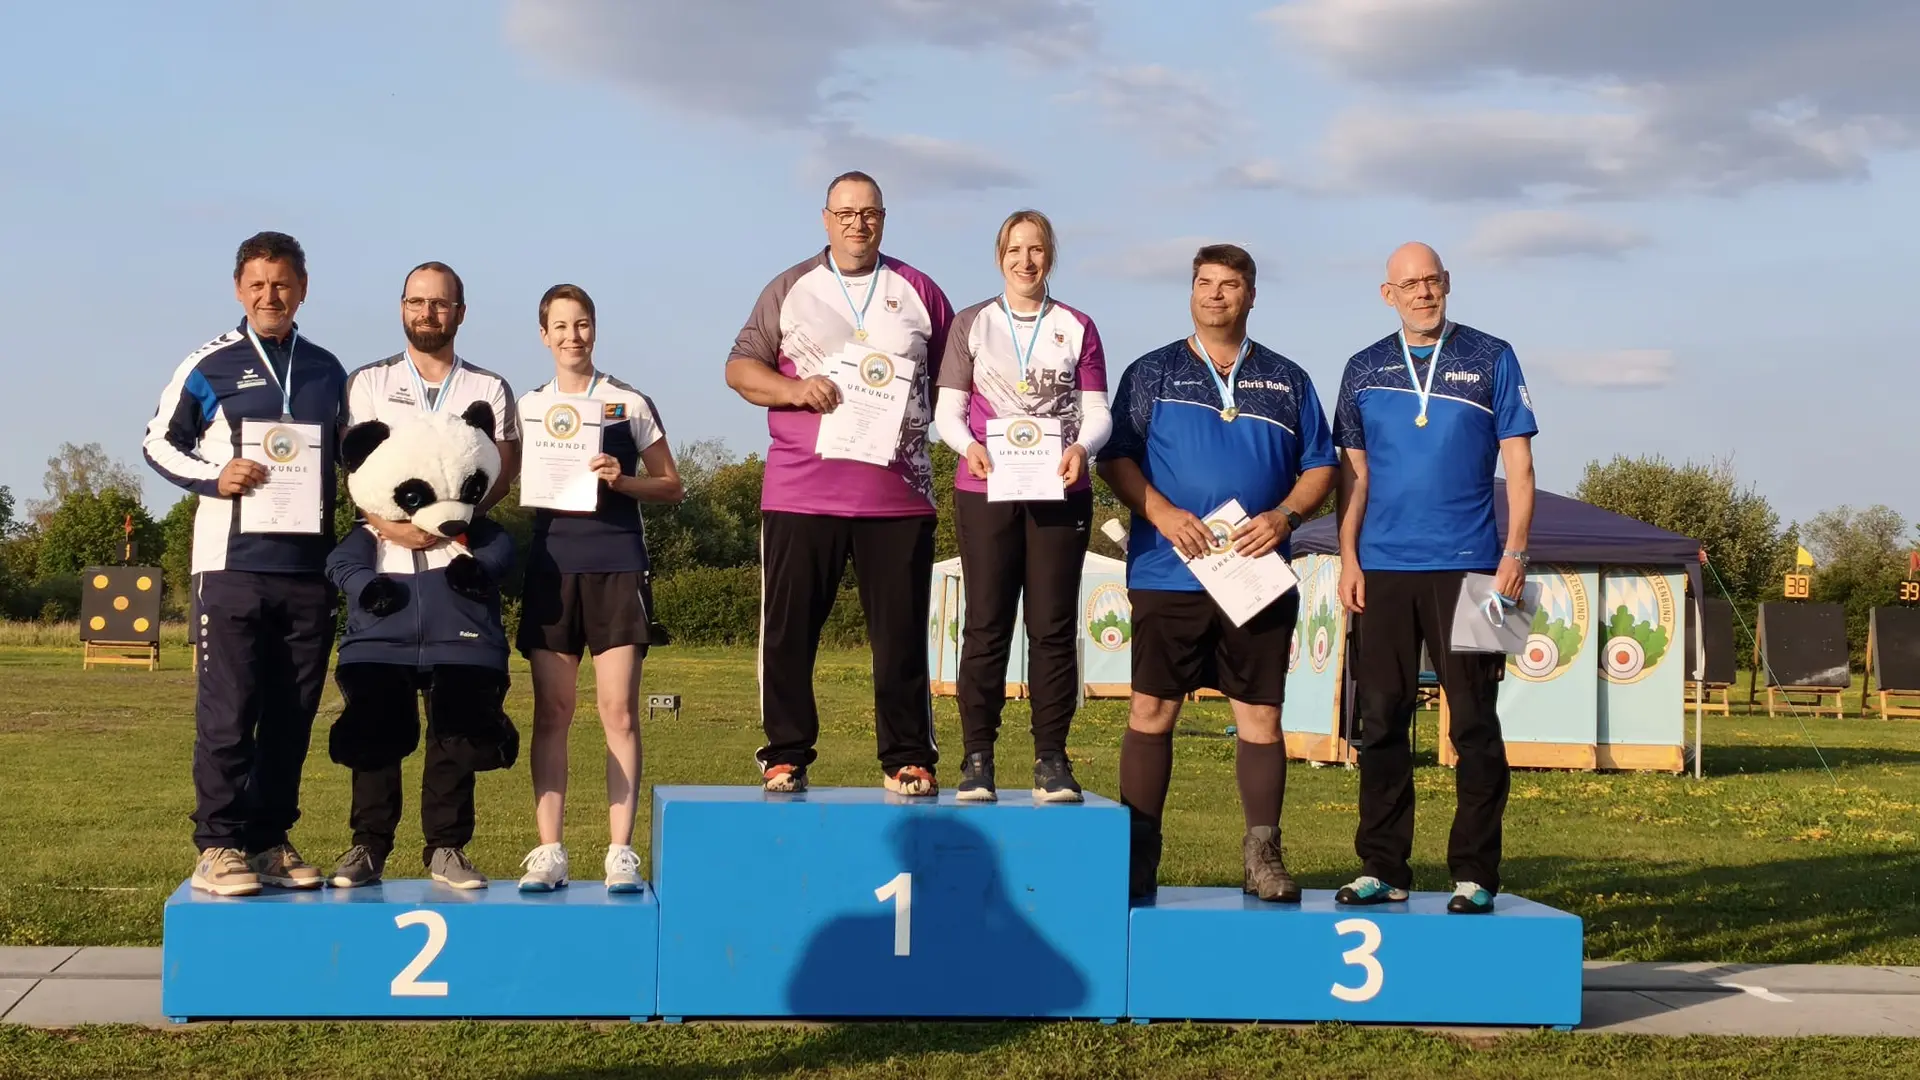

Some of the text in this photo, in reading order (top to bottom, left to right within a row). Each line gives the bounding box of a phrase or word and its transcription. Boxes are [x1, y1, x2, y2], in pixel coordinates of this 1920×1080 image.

[1238, 380, 1290, 392] Chris Rohe
[1445, 371, 1480, 383] Philipp
[847, 383, 896, 401] URKUNDE
[536, 441, 587, 450] URKUNDE
[270, 465, 308, 473] KUNDE
[1211, 552, 1236, 572] URKU
[1788, 577, 1807, 595] 38
[1900, 581, 1920, 600] 39
[1567, 573, 1585, 620] TZENBUND
[1653, 574, 1671, 622] TZENBUND
[875, 872, 912, 956] 1
[391, 910, 448, 996] 2
[1331, 918, 1384, 1002] 3
